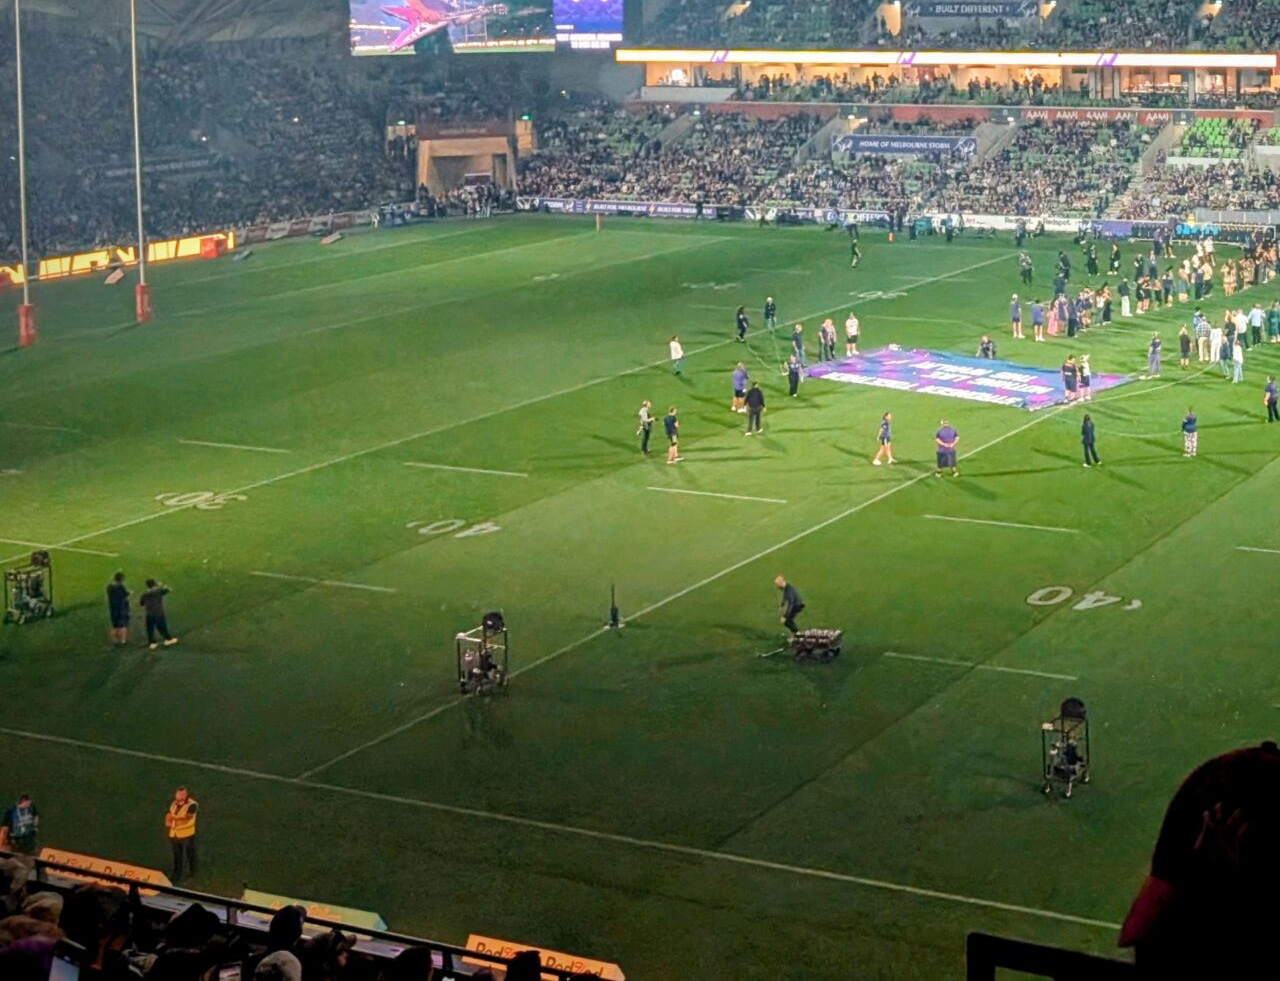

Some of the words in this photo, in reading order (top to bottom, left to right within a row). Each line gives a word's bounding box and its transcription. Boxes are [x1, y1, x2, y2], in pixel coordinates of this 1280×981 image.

[935, 5, 958, 13] BUILT
[960, 5, 1003, 14] DIFFERENT
[1027, 109, 1048, 119] AAMI
[1057, 110, 1078, 119] AAMI
[1086, 111, 1108, 119] AAMI
[1026, 585, 1121, 610] 40
